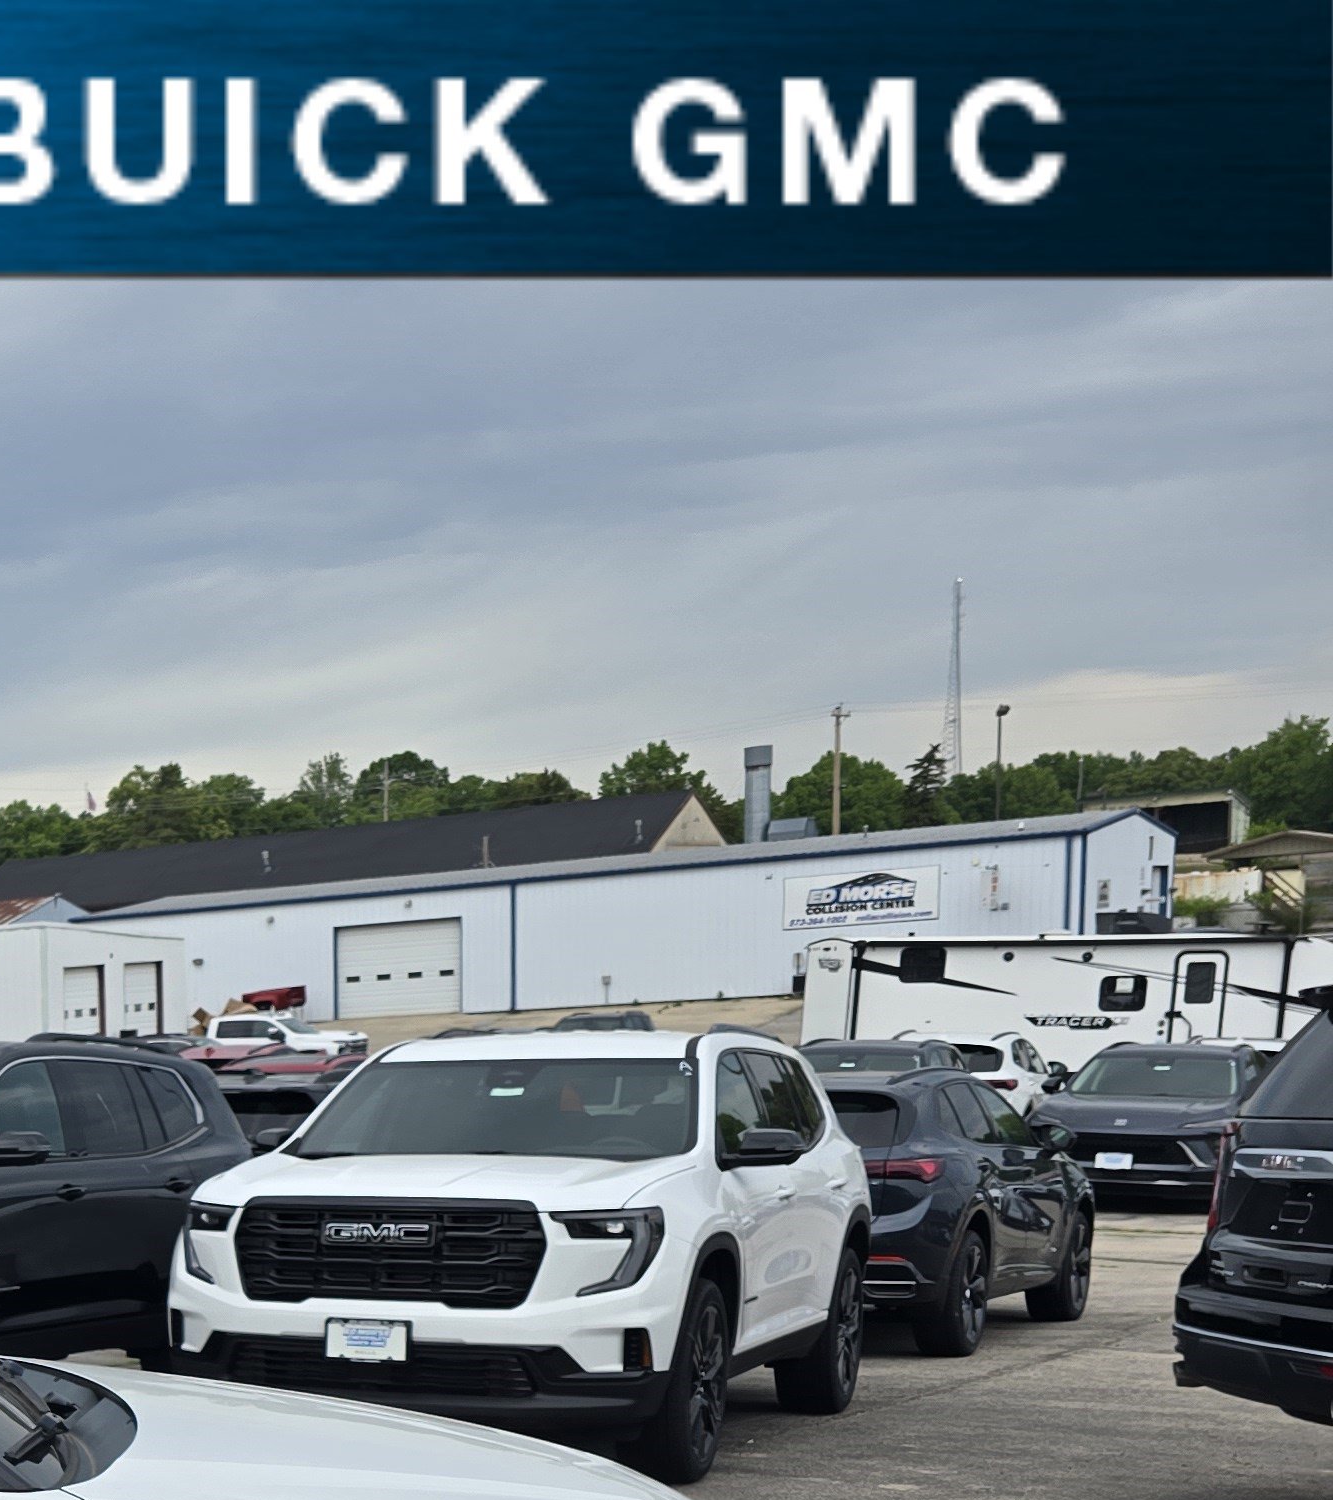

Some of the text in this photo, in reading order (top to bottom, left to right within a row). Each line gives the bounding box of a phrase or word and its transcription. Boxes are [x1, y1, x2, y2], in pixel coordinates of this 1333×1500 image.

[808, 880, 917, 904] ED MORSE
[806, 899, 915, 915] COLLISION CENTER
[1036, 1016, 1106, 1026] TRACER
[325, 1222, 430, 1244] GMC
